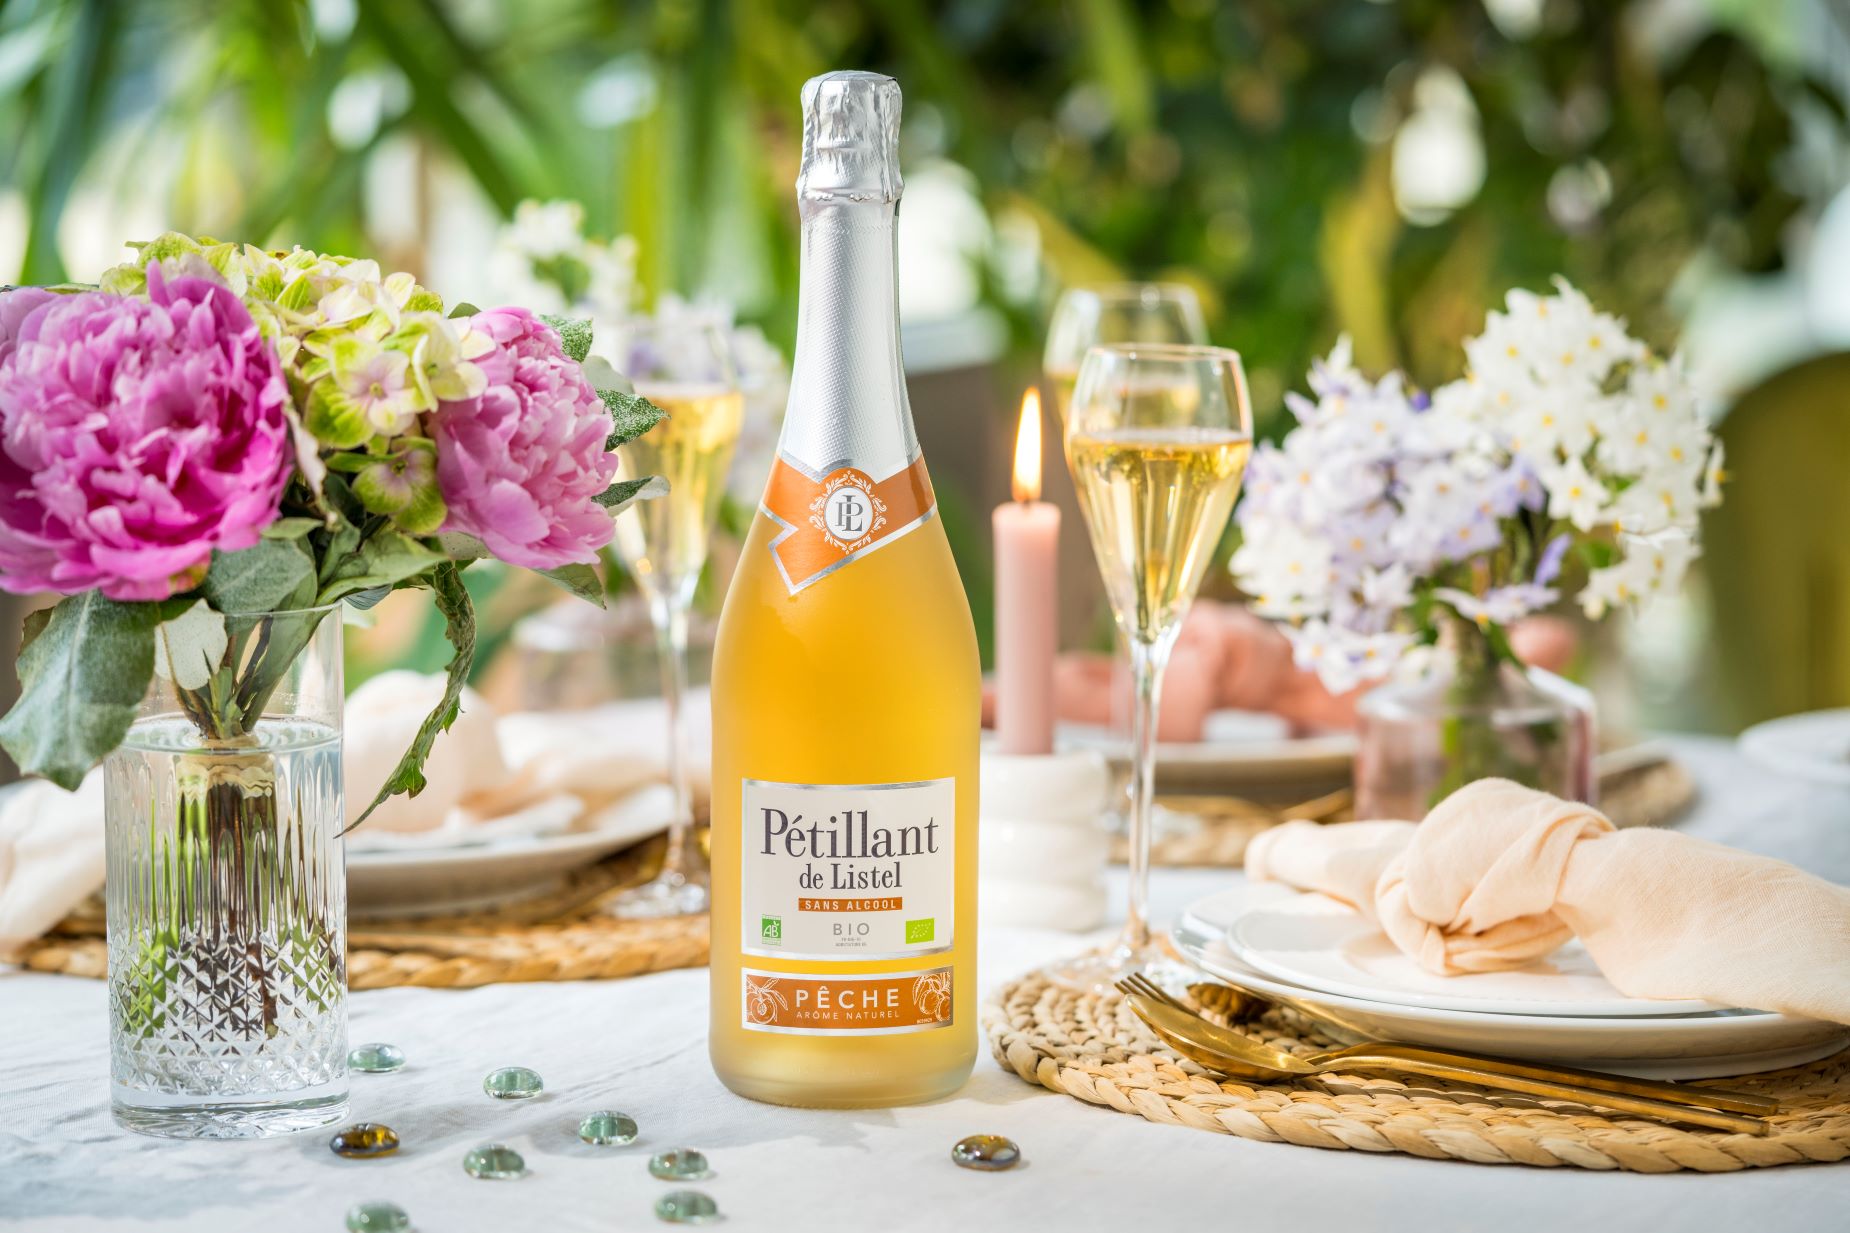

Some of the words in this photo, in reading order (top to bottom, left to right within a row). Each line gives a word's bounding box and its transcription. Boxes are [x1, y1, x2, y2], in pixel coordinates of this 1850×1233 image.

[760, 807, 939, 859] Pétillant
[799, 863, 824, 889] de
[830, 861, 903, 890] Listel
[804, 899, 840, 911] SANS
[846, 898, 897, 911] ALCOOL
[763, 922, 779, 938] AB
[833, 922, 870, 936] BIO
[795, 985, 900, 1009] PÊCHE
[796, 1009, 839, 1020] ARÔME
[846, 1010, 900, 1021] NATUREL
